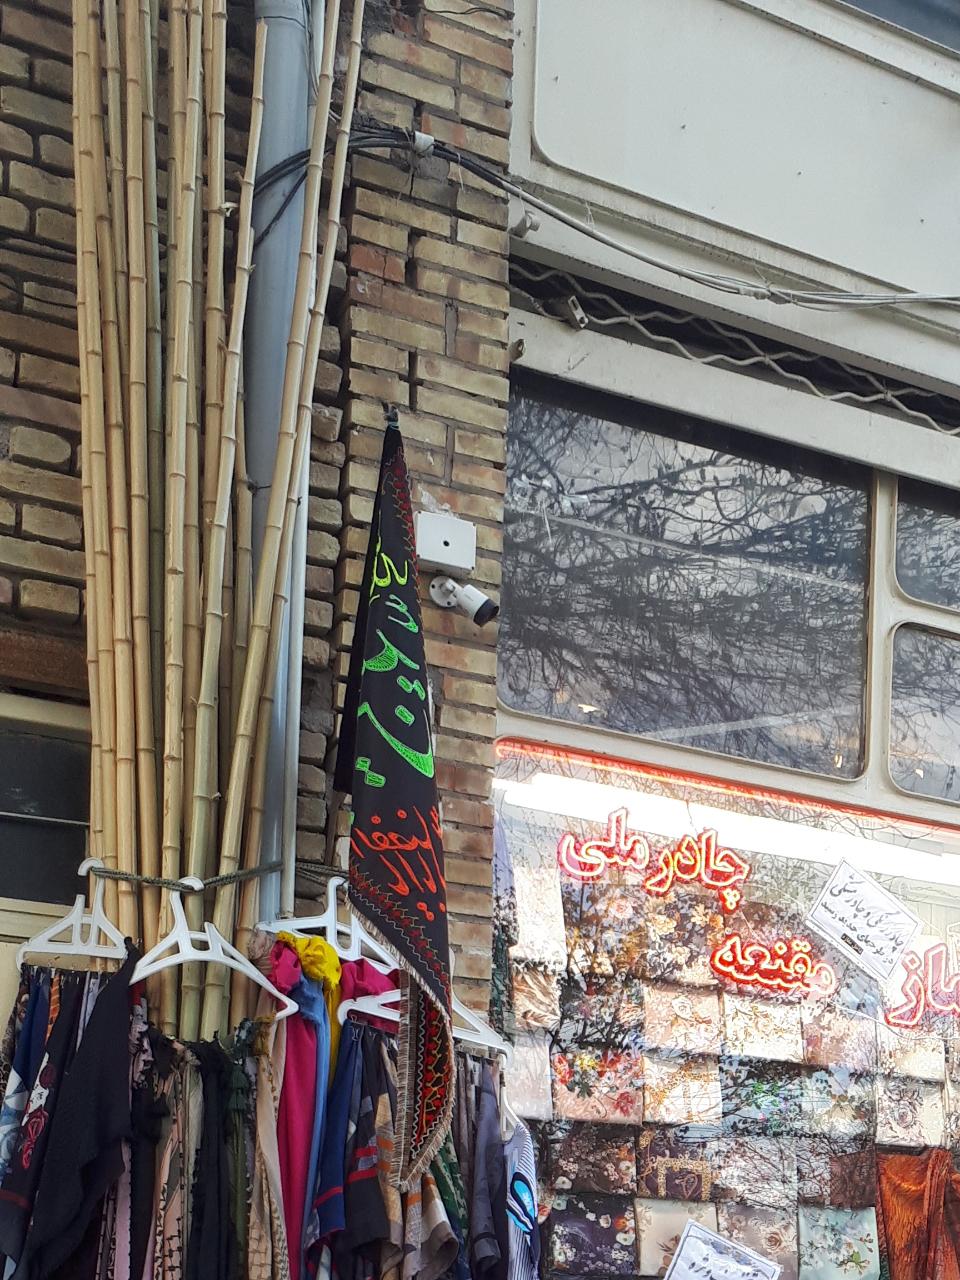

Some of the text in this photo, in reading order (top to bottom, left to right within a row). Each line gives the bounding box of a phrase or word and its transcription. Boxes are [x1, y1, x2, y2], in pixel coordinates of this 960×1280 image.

[558, 806, 750, 911] چادر ملی
[829, 873, 866, 897] مشکی
[821, 901, 839, 919] رسید
[845, 899, 866, 919] چادر
[884, 932, 904, 953] چادر
[711, 935, 836, 995] مقنعه
